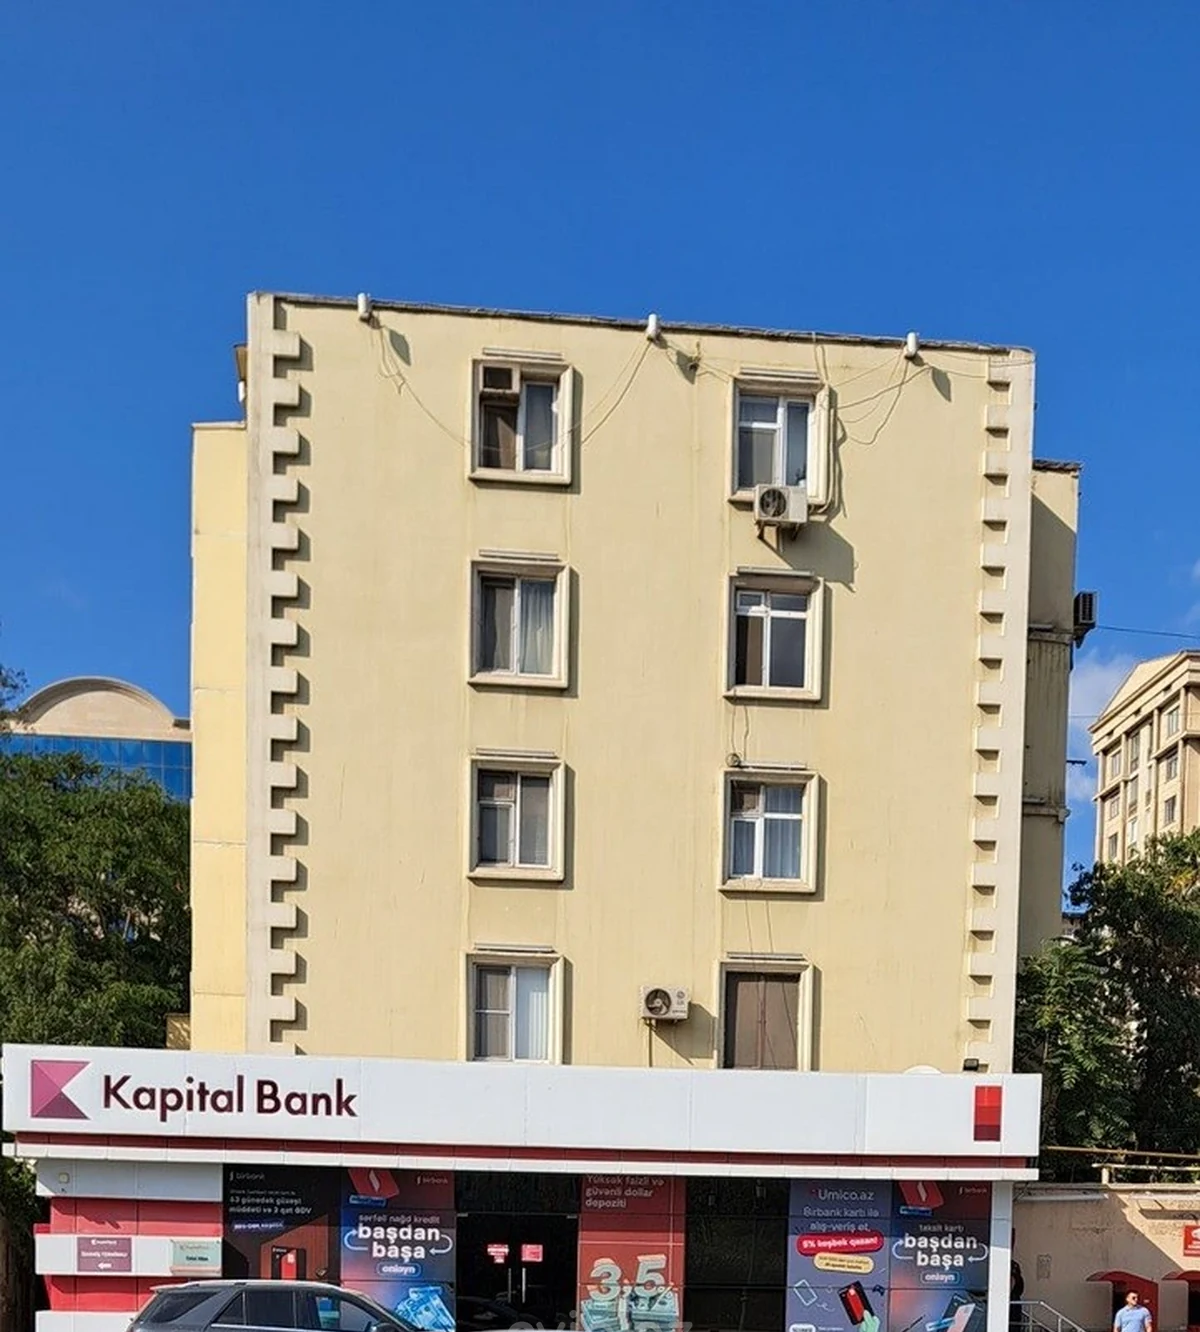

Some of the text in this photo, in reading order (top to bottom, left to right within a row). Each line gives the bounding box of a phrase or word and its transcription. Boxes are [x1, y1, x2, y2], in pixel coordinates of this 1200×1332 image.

[103, 1074, 358, 1123] Kapital Bank
[624, 1188, 654, 1198] dollar
[818, 1188, 875, 1201] Umico.az
[585, 1198, 627, 1209] depoziti
[414, 1215, 440, 1224] kredit
[358, 1223, 441, 1244] başdan
[904, 1233, 978, 1253] başdan
[372, 1241, 426, 1264] başa
[916, 1250, 964, 1271] başa
[381, 1264, 416, 1275] onlayn
[924, 1272, 956, 1283] onlayn
